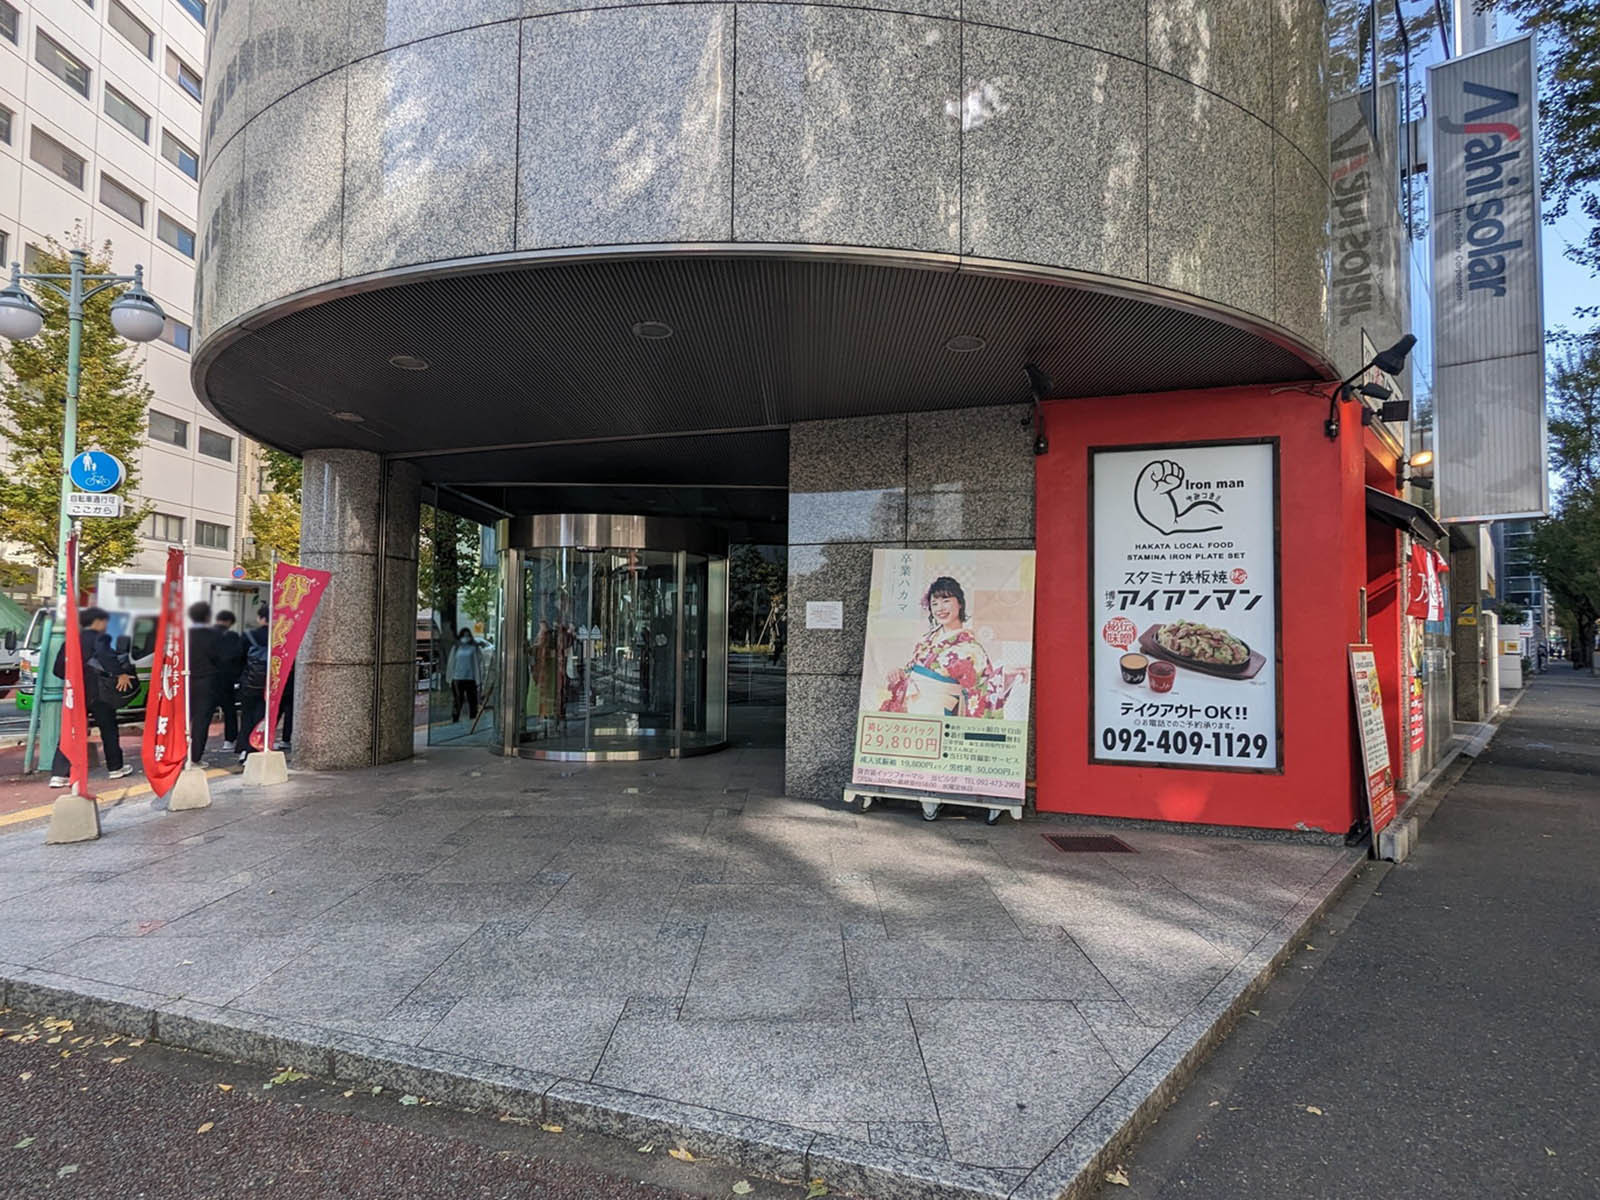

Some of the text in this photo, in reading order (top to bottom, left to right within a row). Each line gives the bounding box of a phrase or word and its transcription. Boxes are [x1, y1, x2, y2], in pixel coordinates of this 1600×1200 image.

[1185, 479, 1245, 490] Iron man
[72, 505, 113, 515] ここから
[1174, 542, 1204, 550] LOCAL
[1208, 541, 1234, 549] FOOD
[1169, 553, 1192, 561] IRON
[1195, 552, 1225, 560] PLATE
[1124, 569, 1229, 585] スタミナ鉄板焼
[1117, 589, 1263, 611] アイアンマン
[864, 734, 938, 752] 29,800円
[1103, 728, 1268, 759] 092-409-1129
